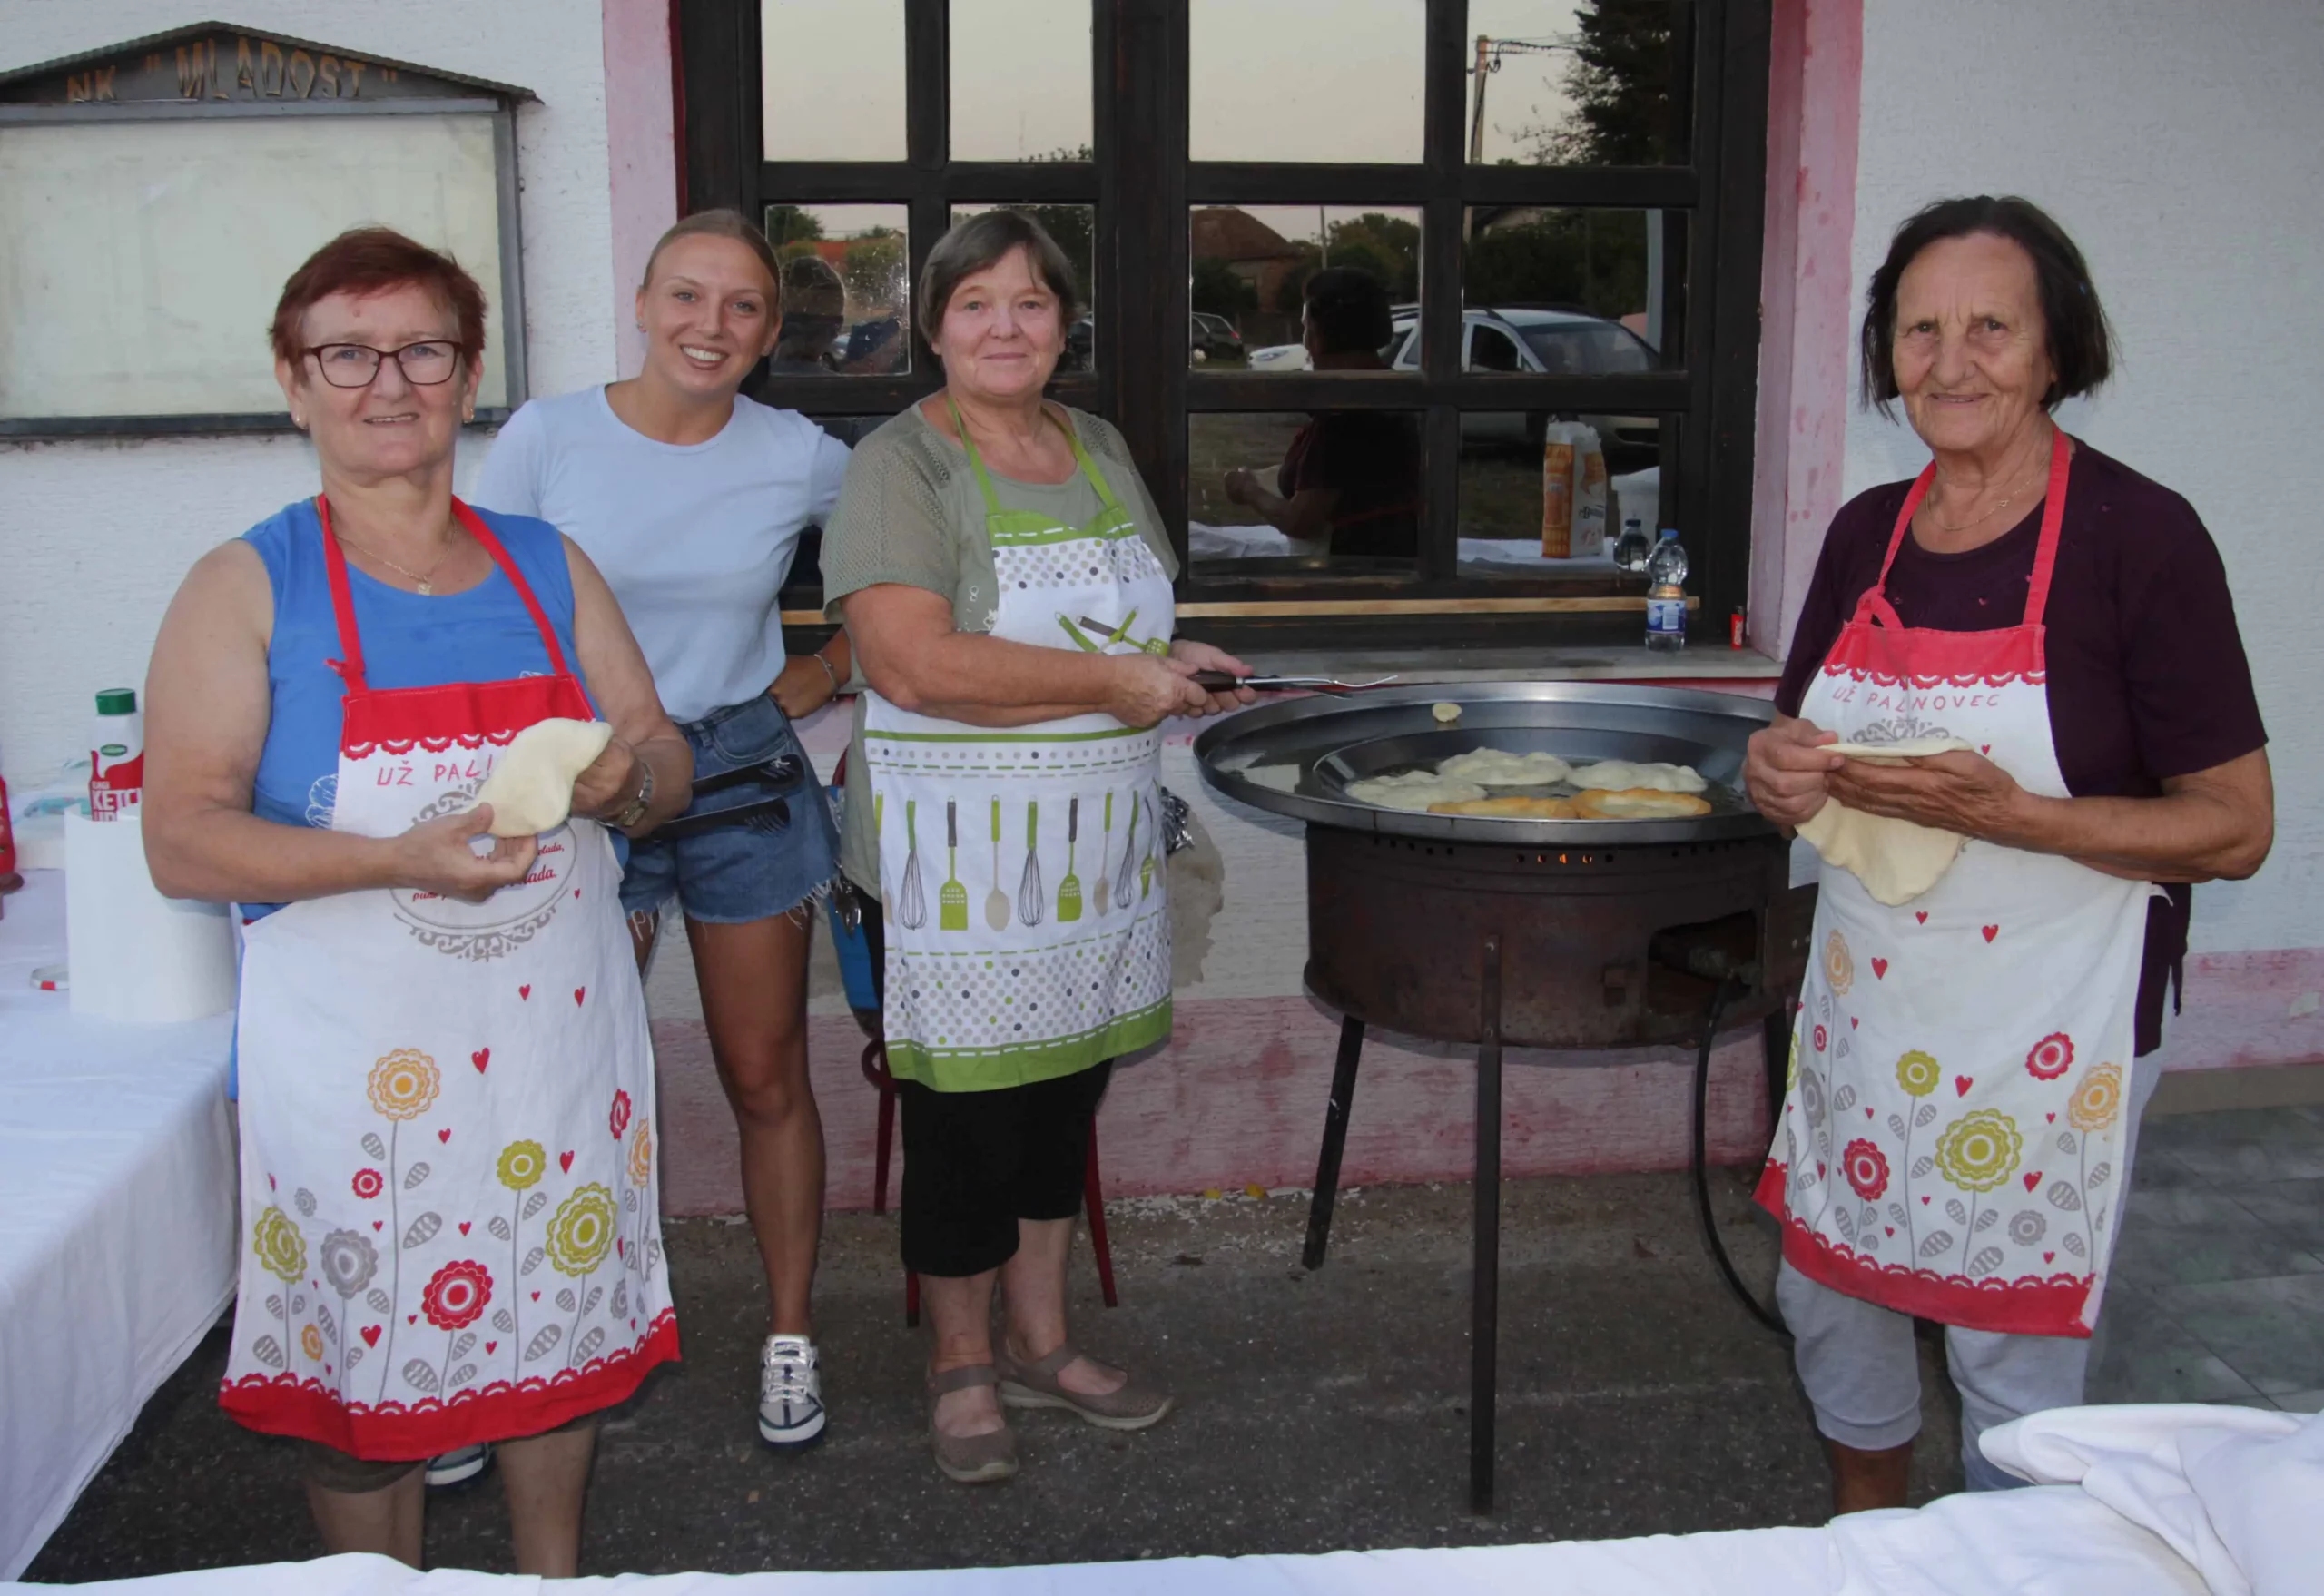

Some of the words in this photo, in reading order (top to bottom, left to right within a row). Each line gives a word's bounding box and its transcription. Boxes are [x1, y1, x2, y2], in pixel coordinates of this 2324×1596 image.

[67, 65, 116, 102] NK
[1832, 685, 1857, 703] UŽ
[1866, 692, 2001, 713] PALNOVEC
[377, 760, 414, 786] UŽ
